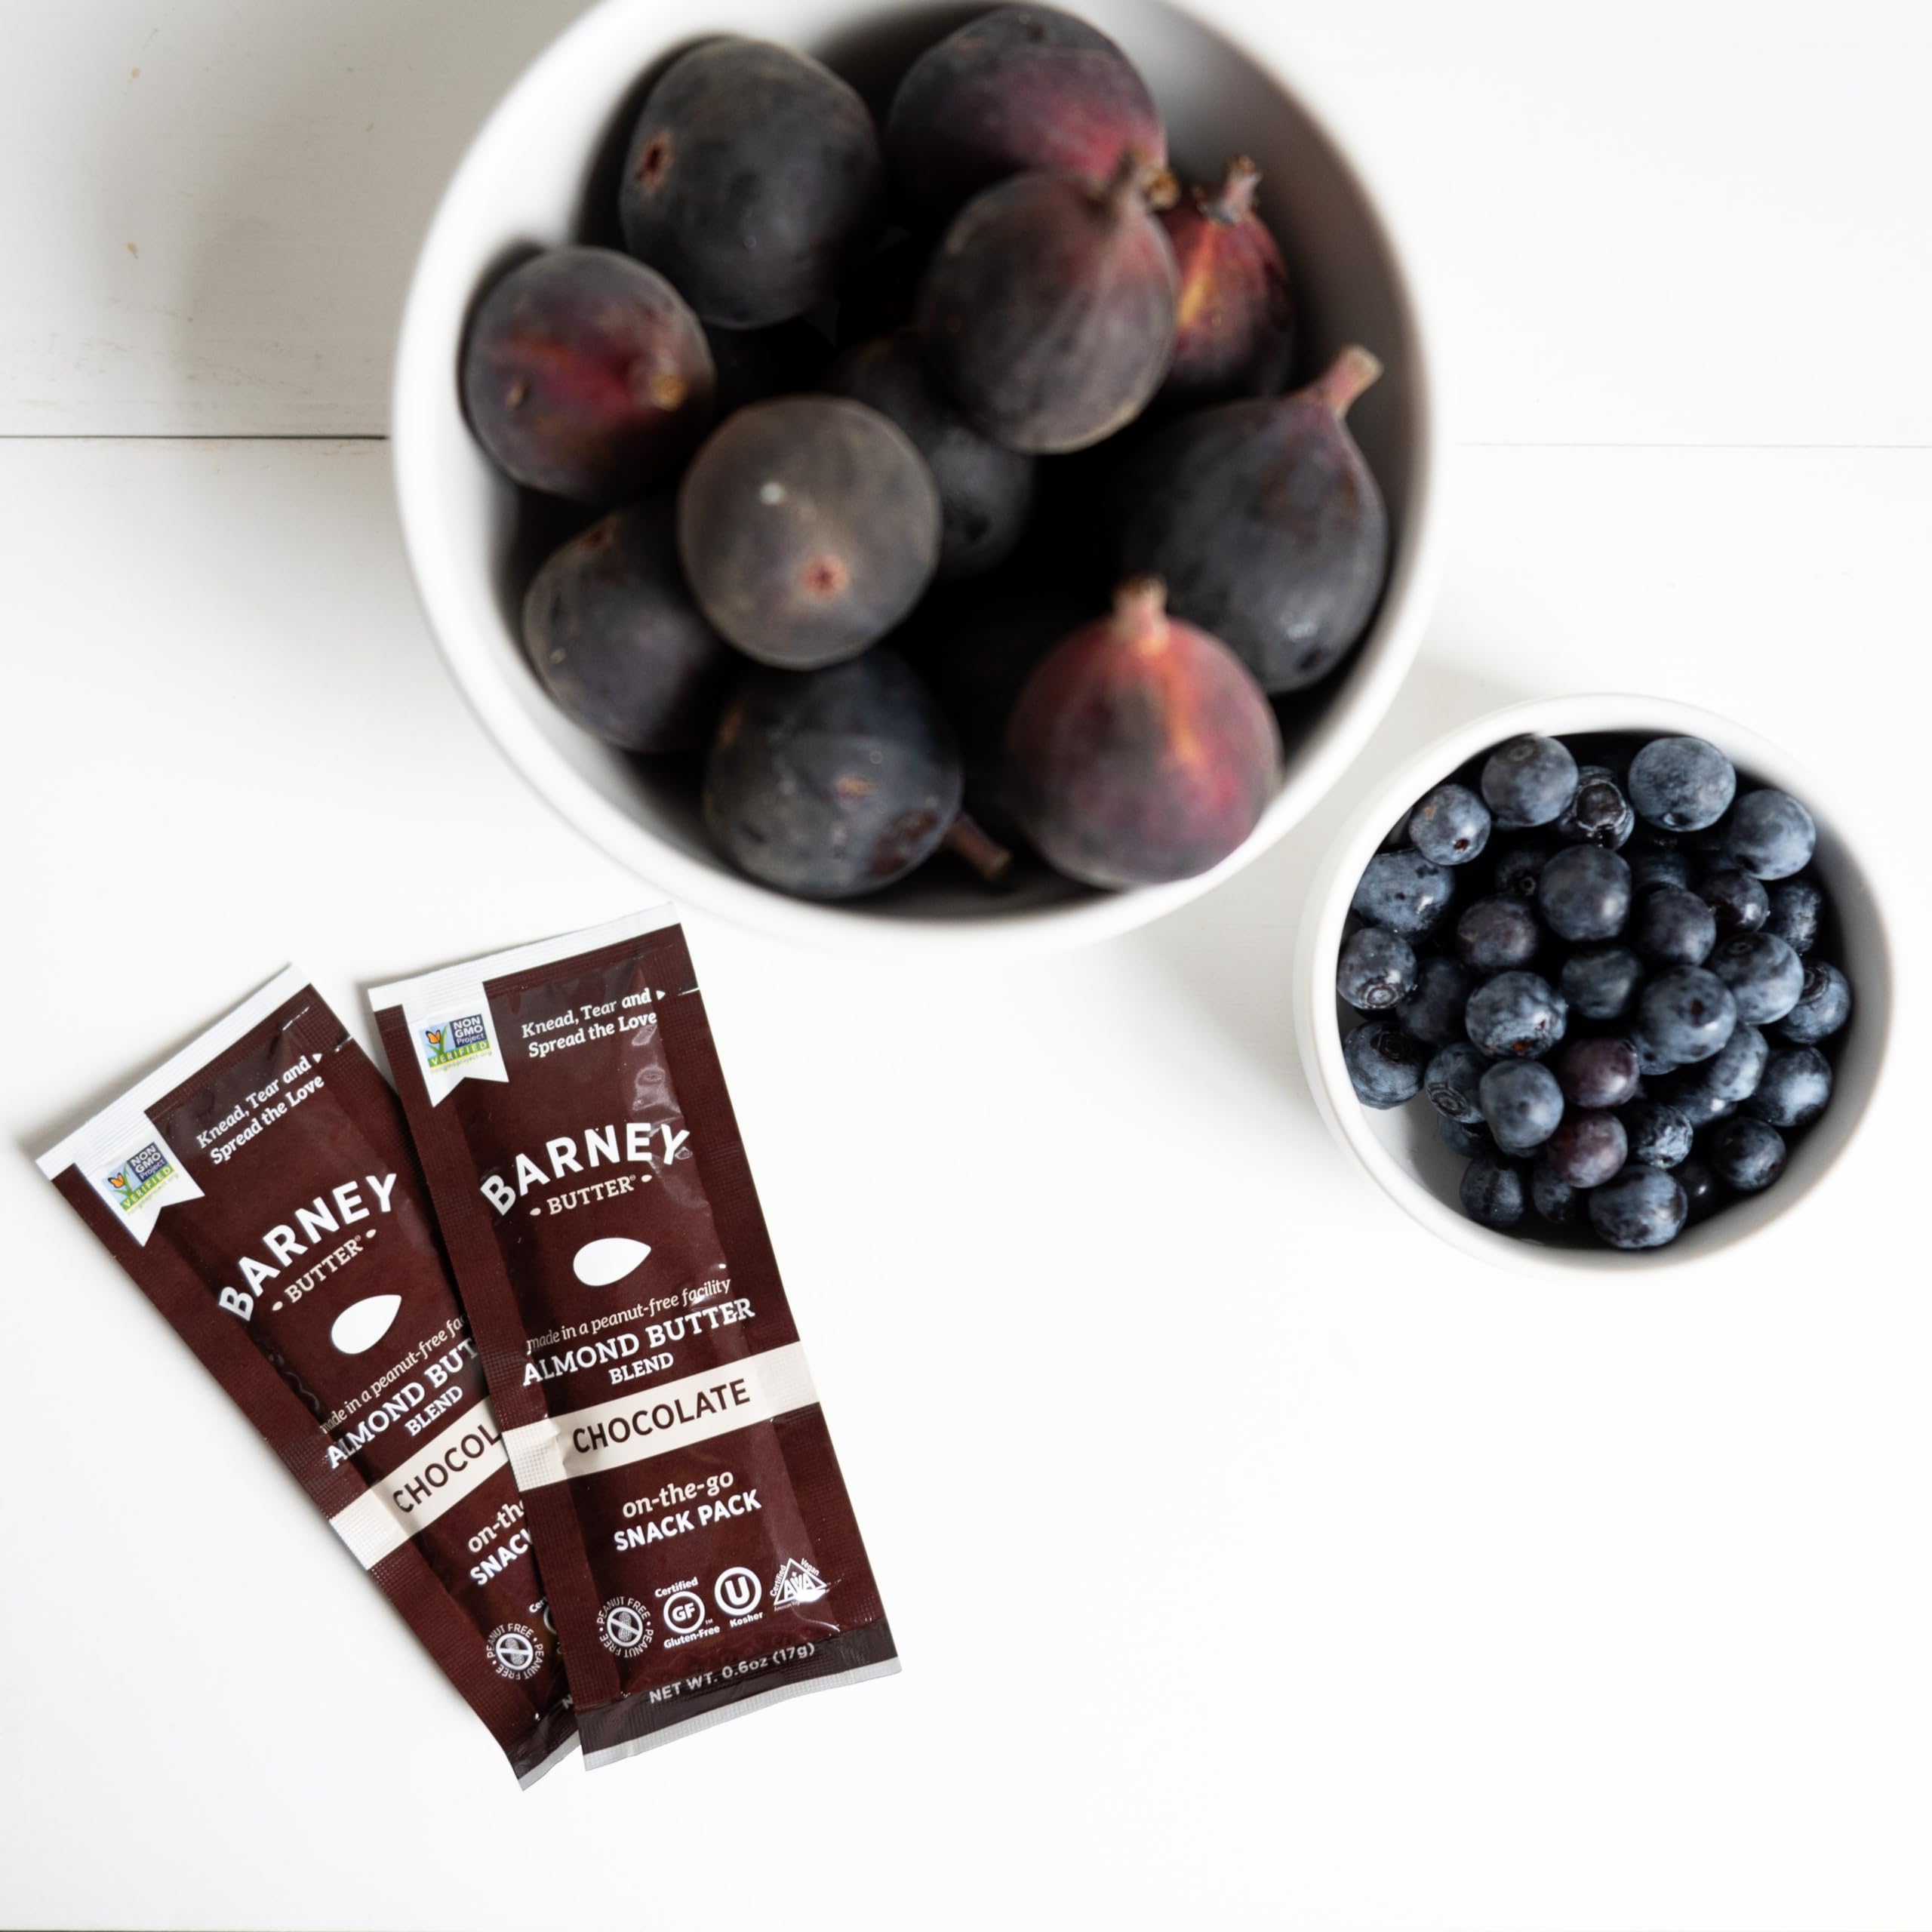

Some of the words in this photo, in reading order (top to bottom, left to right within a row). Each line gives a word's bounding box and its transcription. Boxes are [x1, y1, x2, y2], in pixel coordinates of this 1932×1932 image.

[453, 1015, 481, 1029] NON
[521, 1011, 580, 1039] Knead,
[580, 1001, 617, 1020] Tear
[622, 989, 652, 1008] and
[454, 1025, 483, 1038] GMO
[457, 1033, 485, 1045] Project
[528, 1029, 586, 1058] Spread
[588, 1023, 615, 1041] the
[619, 1013, 657, 1032] Love
[430, 1042, 488, 1066] VERIFIED
[196, 1105, 250, 1149] Knead,
[247, 1078, 280, 1109] Tear
[283, 1057, 312, 1083] and
[210, 1121, 262, 1164] Spread
[263, 1101, 288, 1124] the
[288, 1076, 325, 1106] Love
[131, 1144, 156, 1165] NON
[135, 1152, 161, 1173] GMO
[139, 1158, 165, 1179] Project
[480, 1122, 690, 1217] BARNEY
[122, 1166, 174, 1208] VERIFIED
[218, 1173, 397, 1321] BARNEY
[527, 1330, 561, 1355] made
[562, 1326, 577, 1340] in
[579, 1321, 589, 1334] a
[592, 1295, 679, 1334] peanut-free
[682, 1278, 731, 1306] facility
[522, 1332, 640, 1386] ALMOND
[645, 1297, 755, 1349] BUTTER
[320, 1409, 346, 1435] made
[346, 1397, 362, 1414] in
[362, 1389, 372, 1402] a
[373, 1330, 447, 1398] peanut-free
[609, 1352, 674, 1384] BLEND
[326, 1381, 425, 1469] ALMOND
[405, 1385, 463, 1436] BLEND
[573, 1378, 750, 1454] CHOCOLATE
[623, 1471, 734, 1518] on-the-go
[614, 1510, 694, 1551] SNACK
[697, 1489, 761, 1527] PACK
[770, 1564, 786, 1596] Certified
[801, 1558, 820, 1576] Vegan
[655, 1577, 698, 1598] Certified
[597, 1596, 625, 1624] PEANUT
[627, 1598, 651, 1620] FREE
[672, 1603, 695, 1620] GF
[730, 1611, 763, 1628] Kosher
[486, 1625, 505, 1658] PEANUT
[507, 1623, 534, 1638] FREE
[599, 1633, 621, 1656] FREE
[624, 1629, 654, 1657] PEANUT
[664, 1625, 720, 1648] Gluten-Free
[495, 1664, 521, 1680] FREE
[524, 1644, 543, 1679] PEANUT
[649, 1681, 681, 1703] NET
[689, 1673, 718, 1690] WT.
[722, 1657, 767, 1679] 0.6oz
[774, 1642, 815, 1665] (17g)
